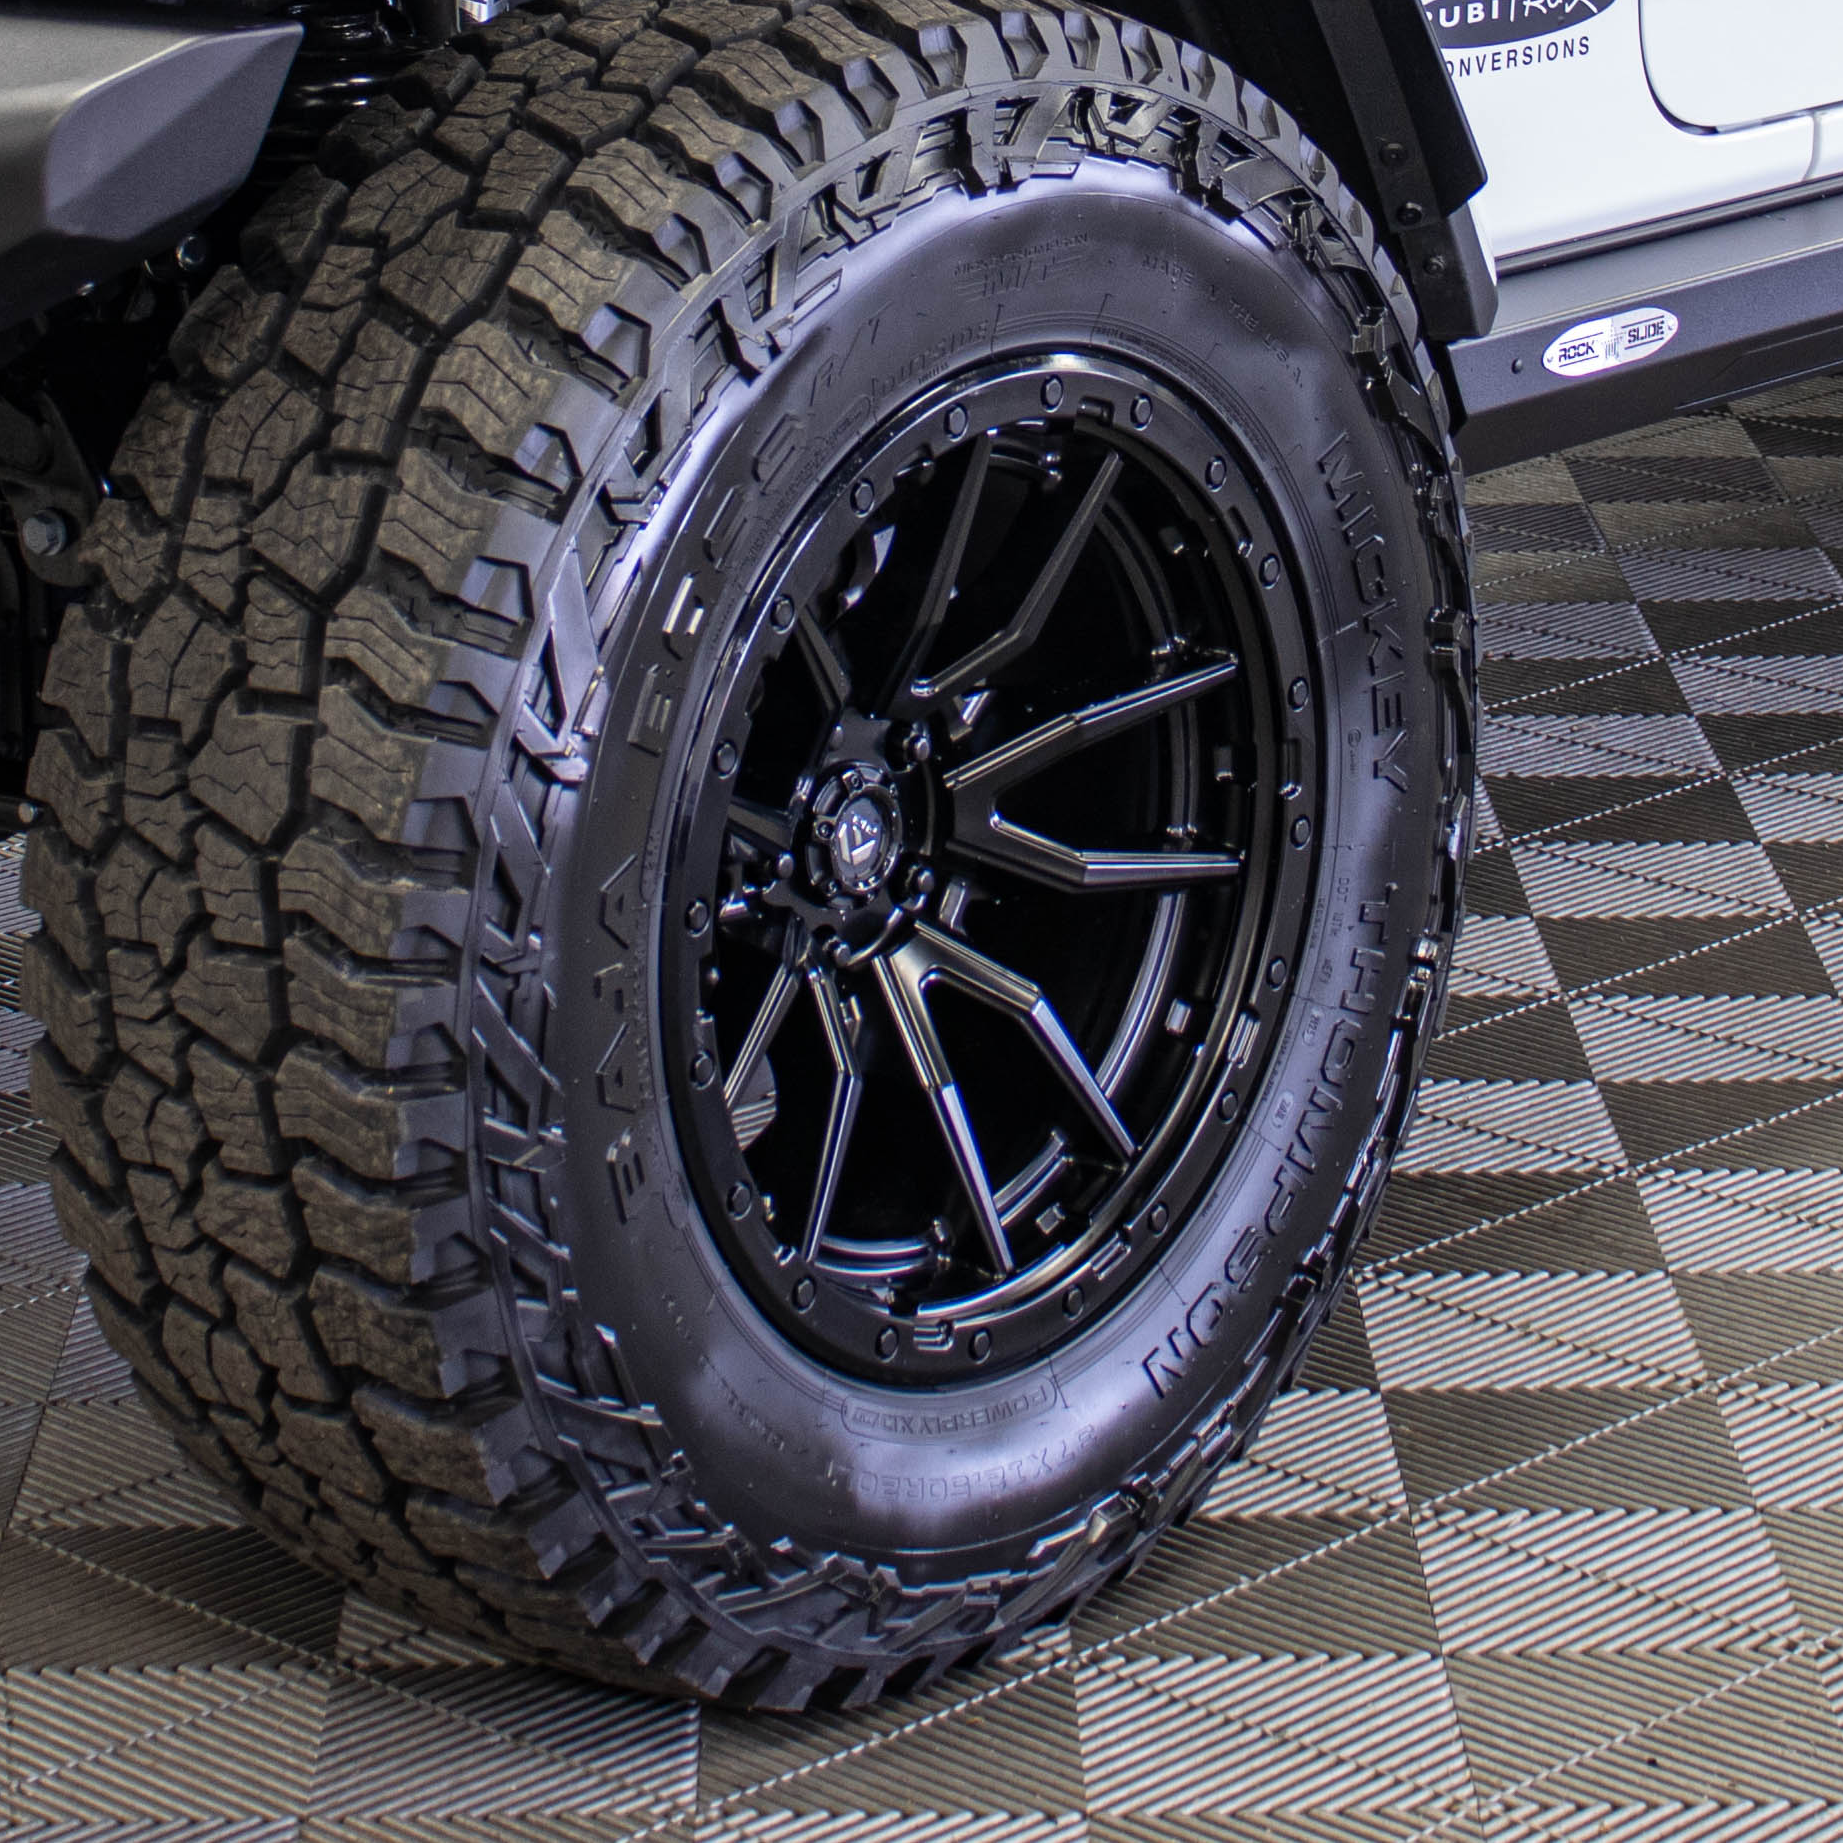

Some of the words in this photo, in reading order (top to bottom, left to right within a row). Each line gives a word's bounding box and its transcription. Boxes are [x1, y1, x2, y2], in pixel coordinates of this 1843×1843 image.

[1445, 35, 1591, 79] ONVERSIONS
[1558, 339, 1596, 363] ROCK
[1627, 320, 1665, 345] SLIDE
[1317, 430, 1411, 794] MICKEY
[594, 852, 646, 1224] BAJA
[626, 413, 806, 756] BOSS
[1142, 881, 1400, 1401] THOMPSON
